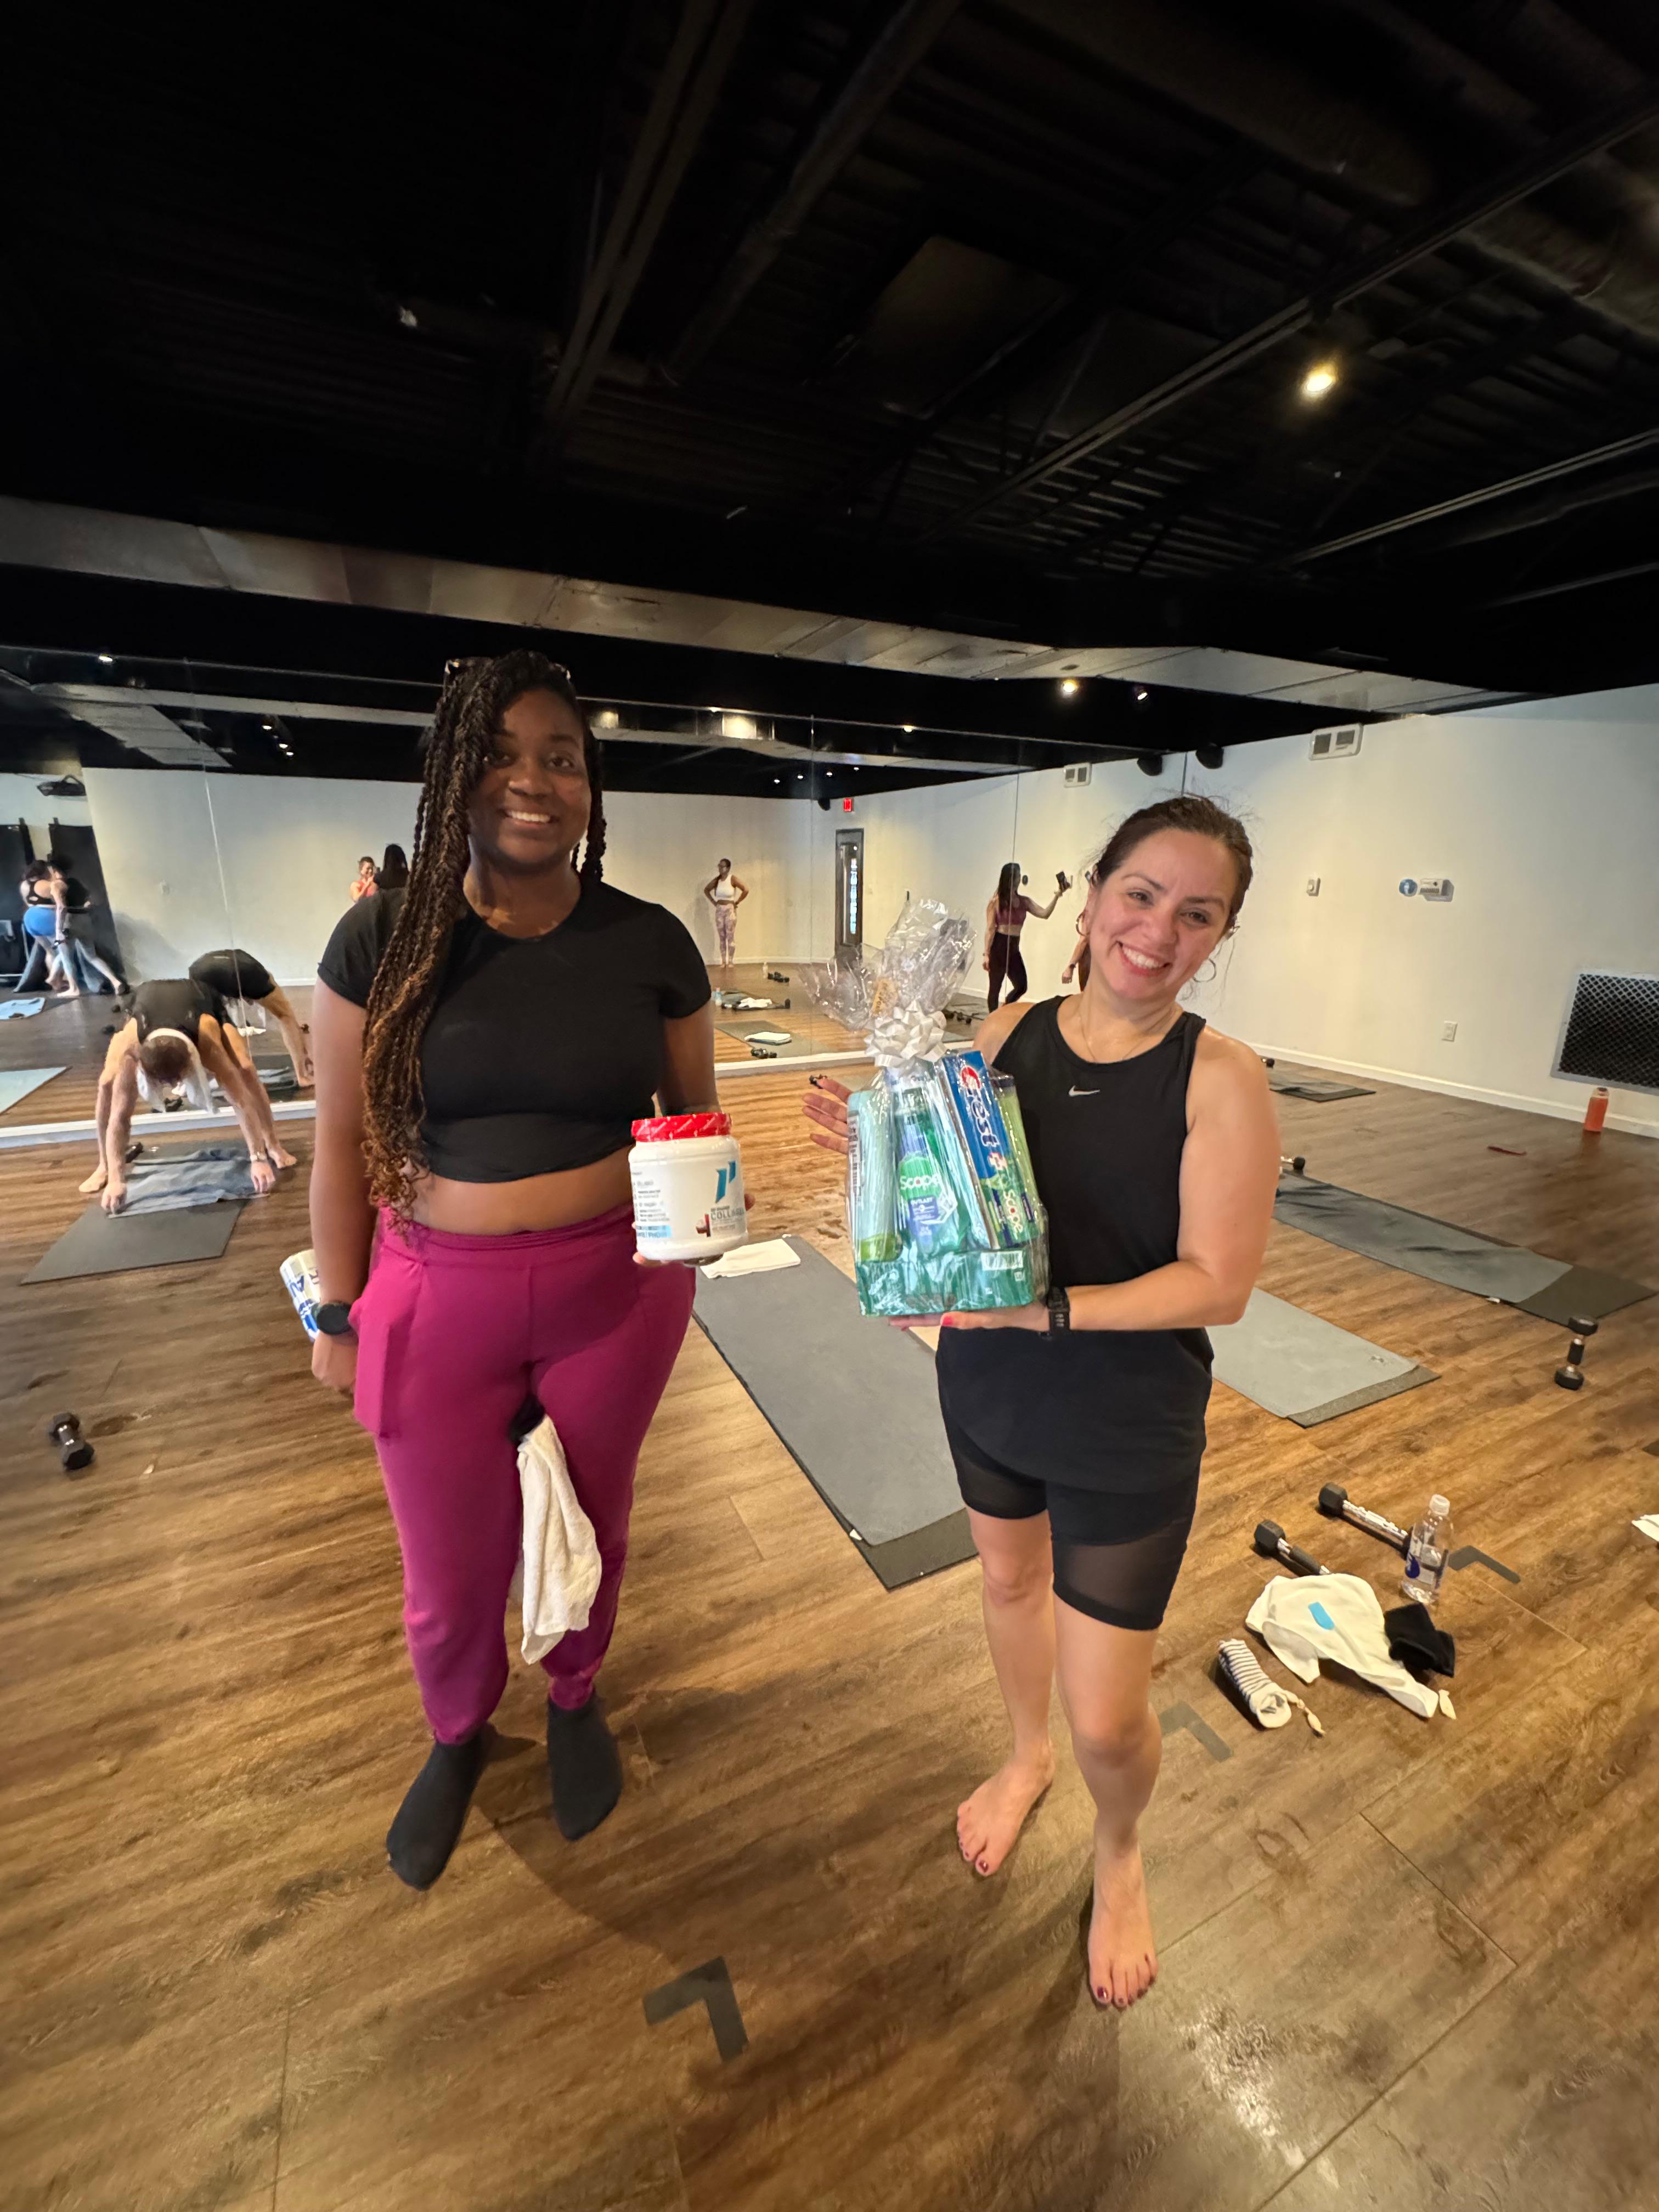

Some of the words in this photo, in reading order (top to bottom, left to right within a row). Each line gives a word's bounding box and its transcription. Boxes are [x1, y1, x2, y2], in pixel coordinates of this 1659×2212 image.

[900, 1175, 940, 1190] Scope
[960, 1066, 1000, 1147] Crest
[1003, 1189, 1024, 1240] Scope
